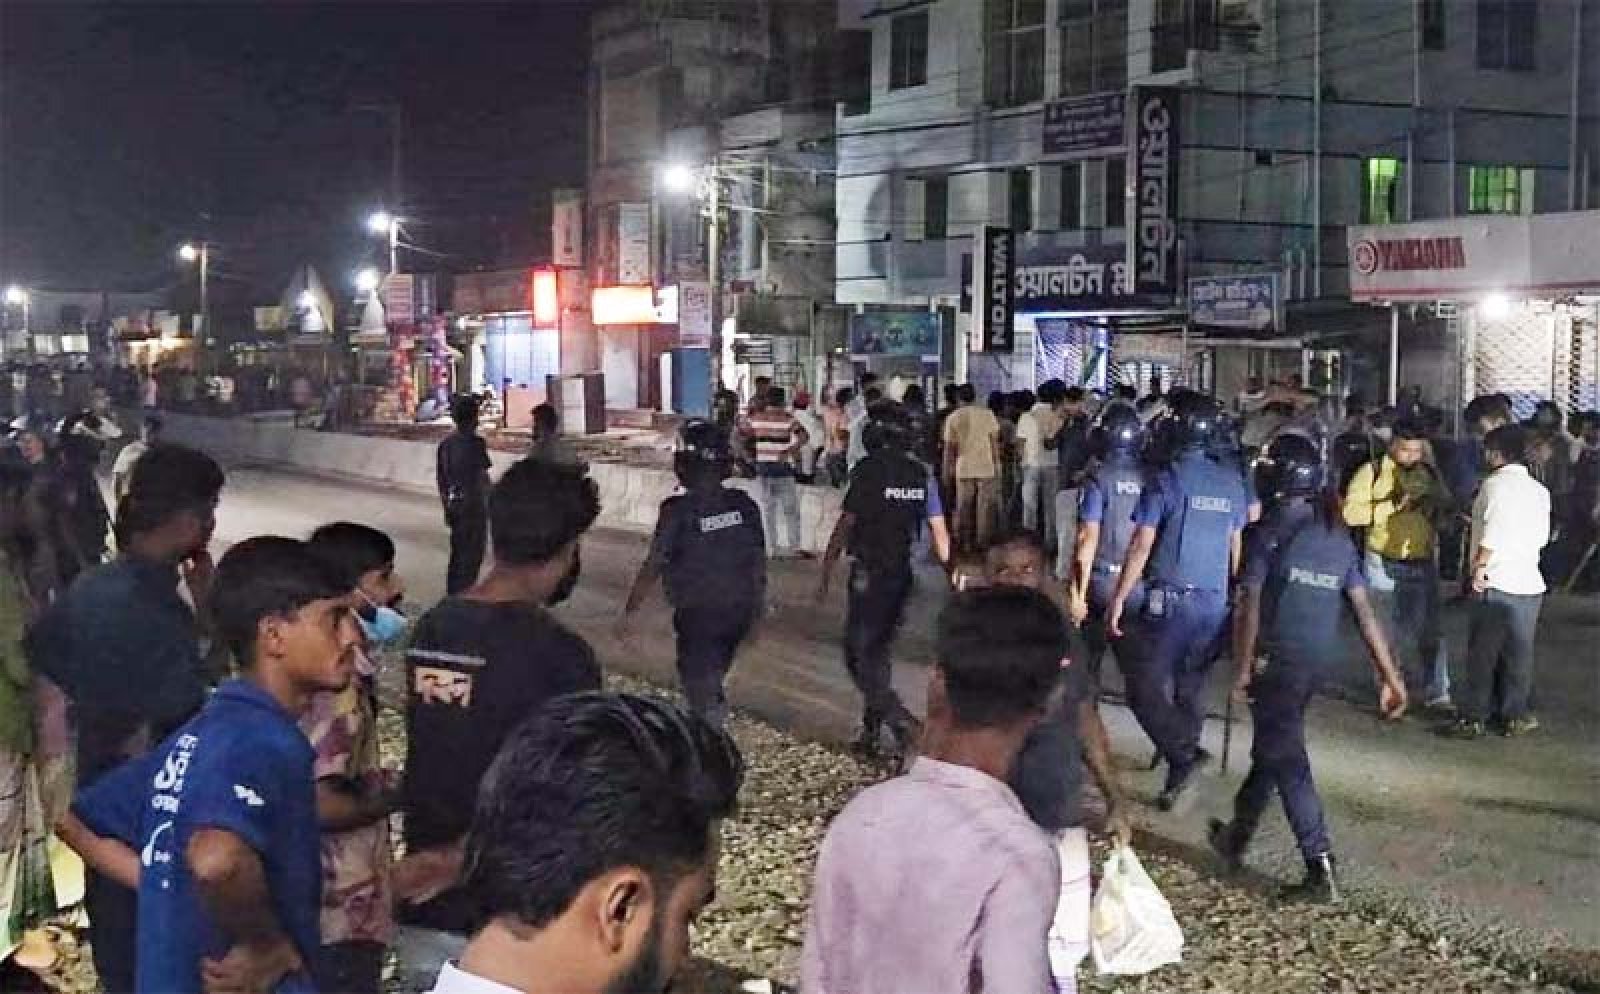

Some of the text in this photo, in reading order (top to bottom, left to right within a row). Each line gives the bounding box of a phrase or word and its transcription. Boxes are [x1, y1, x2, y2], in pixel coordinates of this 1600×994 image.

[992, 235, 1007, 344] WALTON
[885, 487, 925, 500] POLICE
[1289, 567, 1340, 590] POLICE
